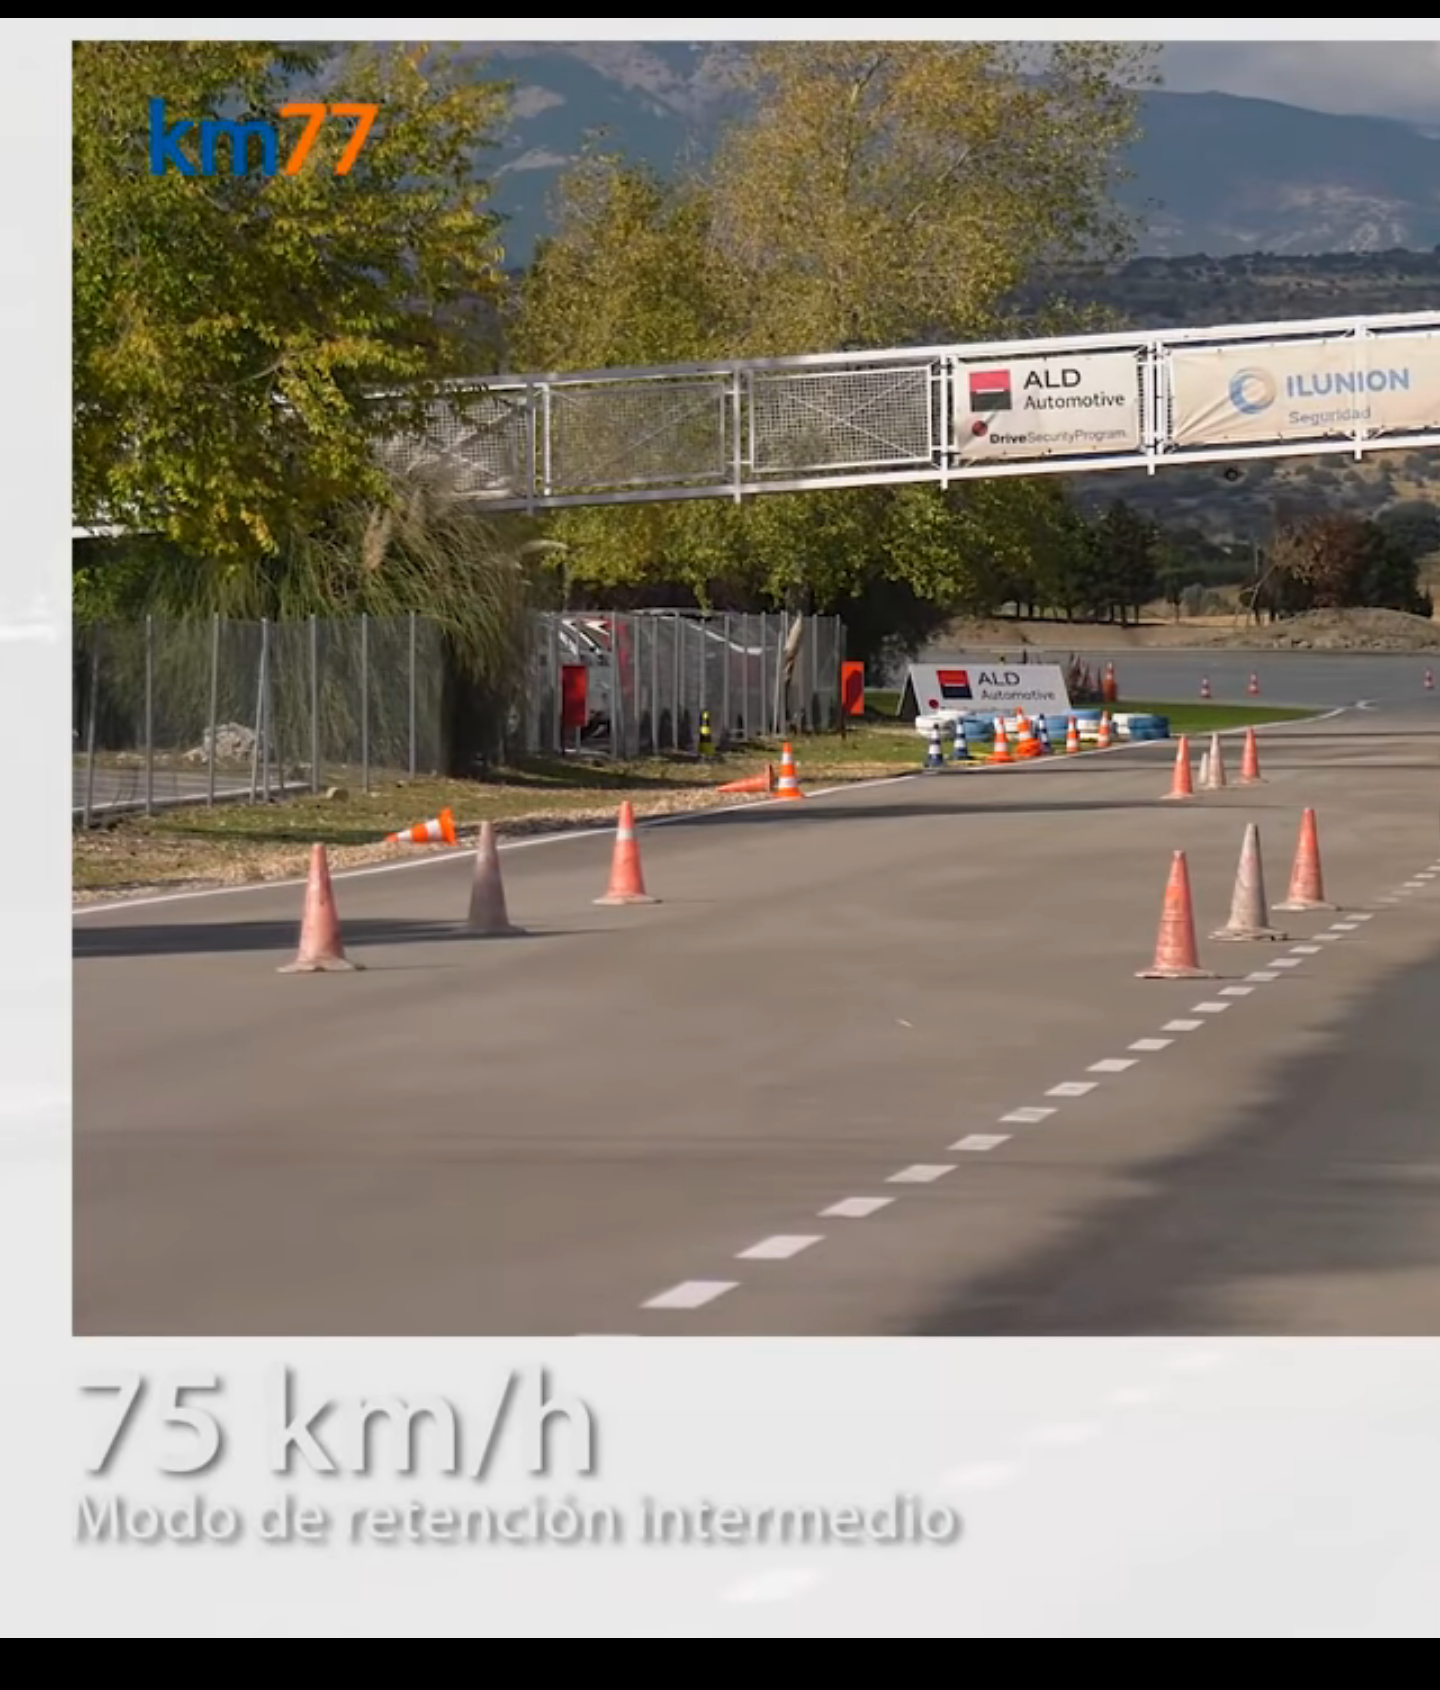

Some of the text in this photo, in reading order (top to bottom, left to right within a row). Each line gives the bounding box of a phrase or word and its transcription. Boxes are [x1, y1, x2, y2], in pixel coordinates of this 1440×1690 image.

[1023, 368, 1082, 390] ALD
[1286, 368, 1411, 397] ILUNION
[1023, 391, 1126, 411] Automotive
[1289, 406, 1372, 426] Seguridad
[978, 672, 1021, 685] ALD
[981, 689, 1055, 700] Automotive
